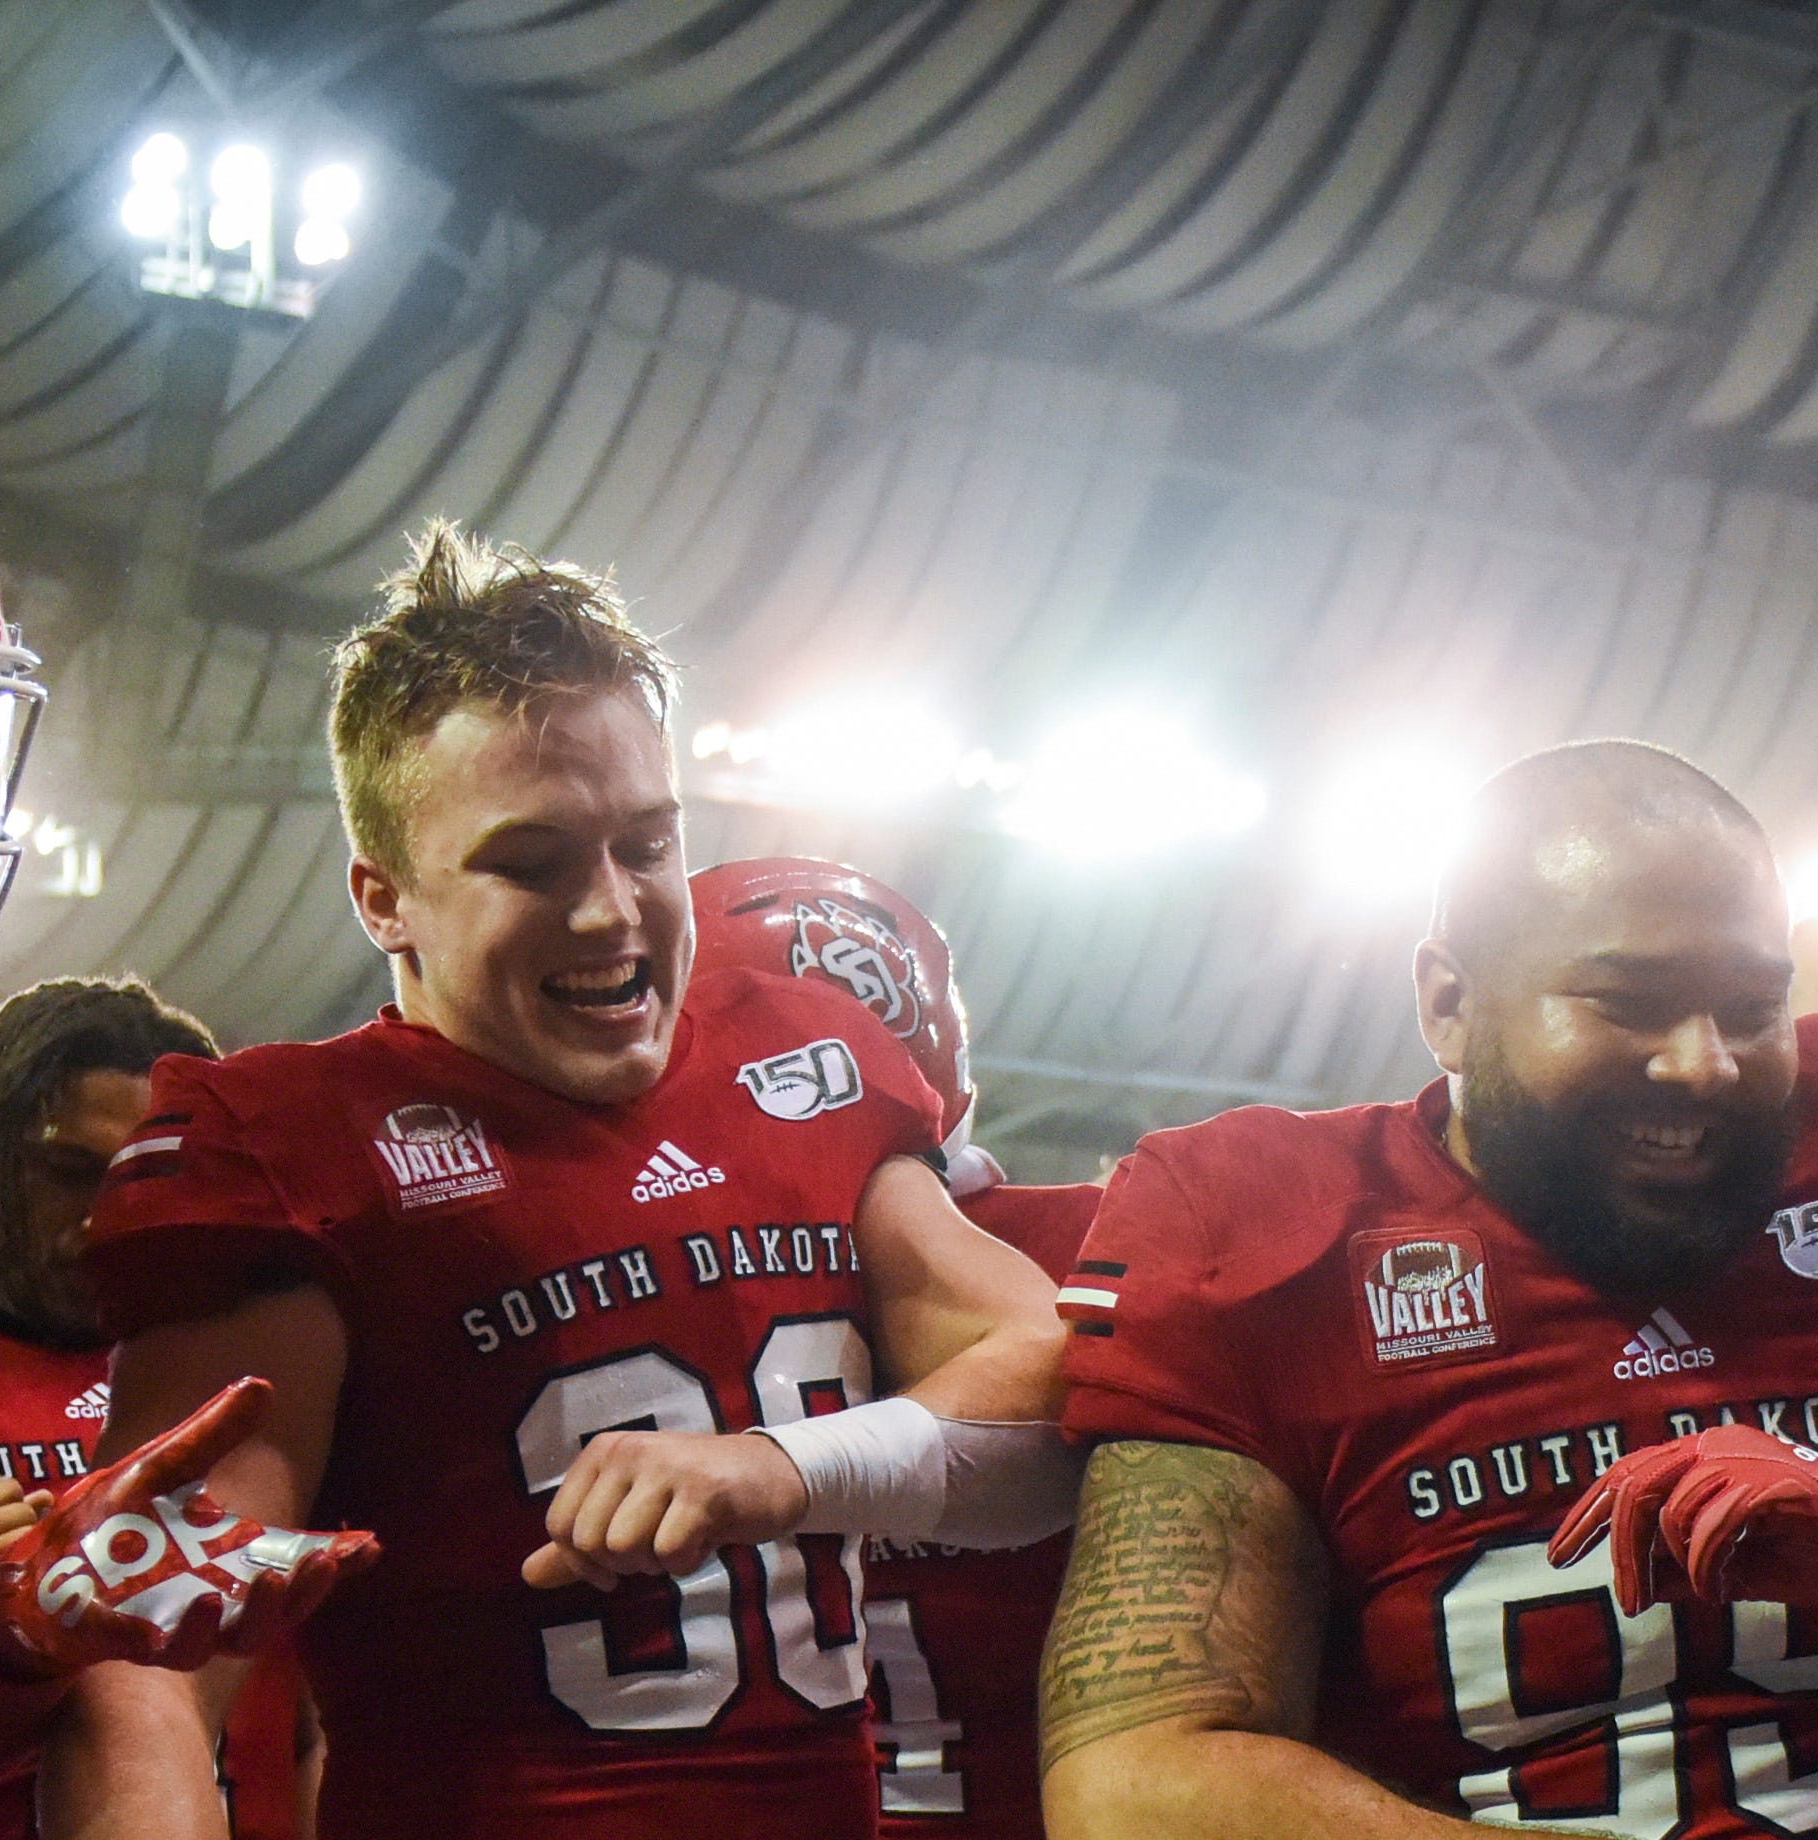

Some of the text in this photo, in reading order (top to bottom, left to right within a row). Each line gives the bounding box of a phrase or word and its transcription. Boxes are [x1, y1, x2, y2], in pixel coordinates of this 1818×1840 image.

[734, 1037, 864, 1121] 150
[374, 1118, 493, 1186] VALLEY
[399, 1170, 501, 1198] MISSOURI VALLEY
[401, 1194, 449, 1212] FOOTBALL
[631, 1165, 726, 1204] adidas
[462, 1250, 656, 1353] SOUTH
[1365, 1262, 1487, 1339] VALLEY
[1376, 1324, 1493, 1351] MISSOURI VALLEY
[1377, 1336, 1497, 1362] FOOTBALL CONFERENCE
[1613, 1347, 1715, 1380] adidas
[1409, 1425, 1623, 1518] SOUTH
[514, 1318, 873, 1730] 30
